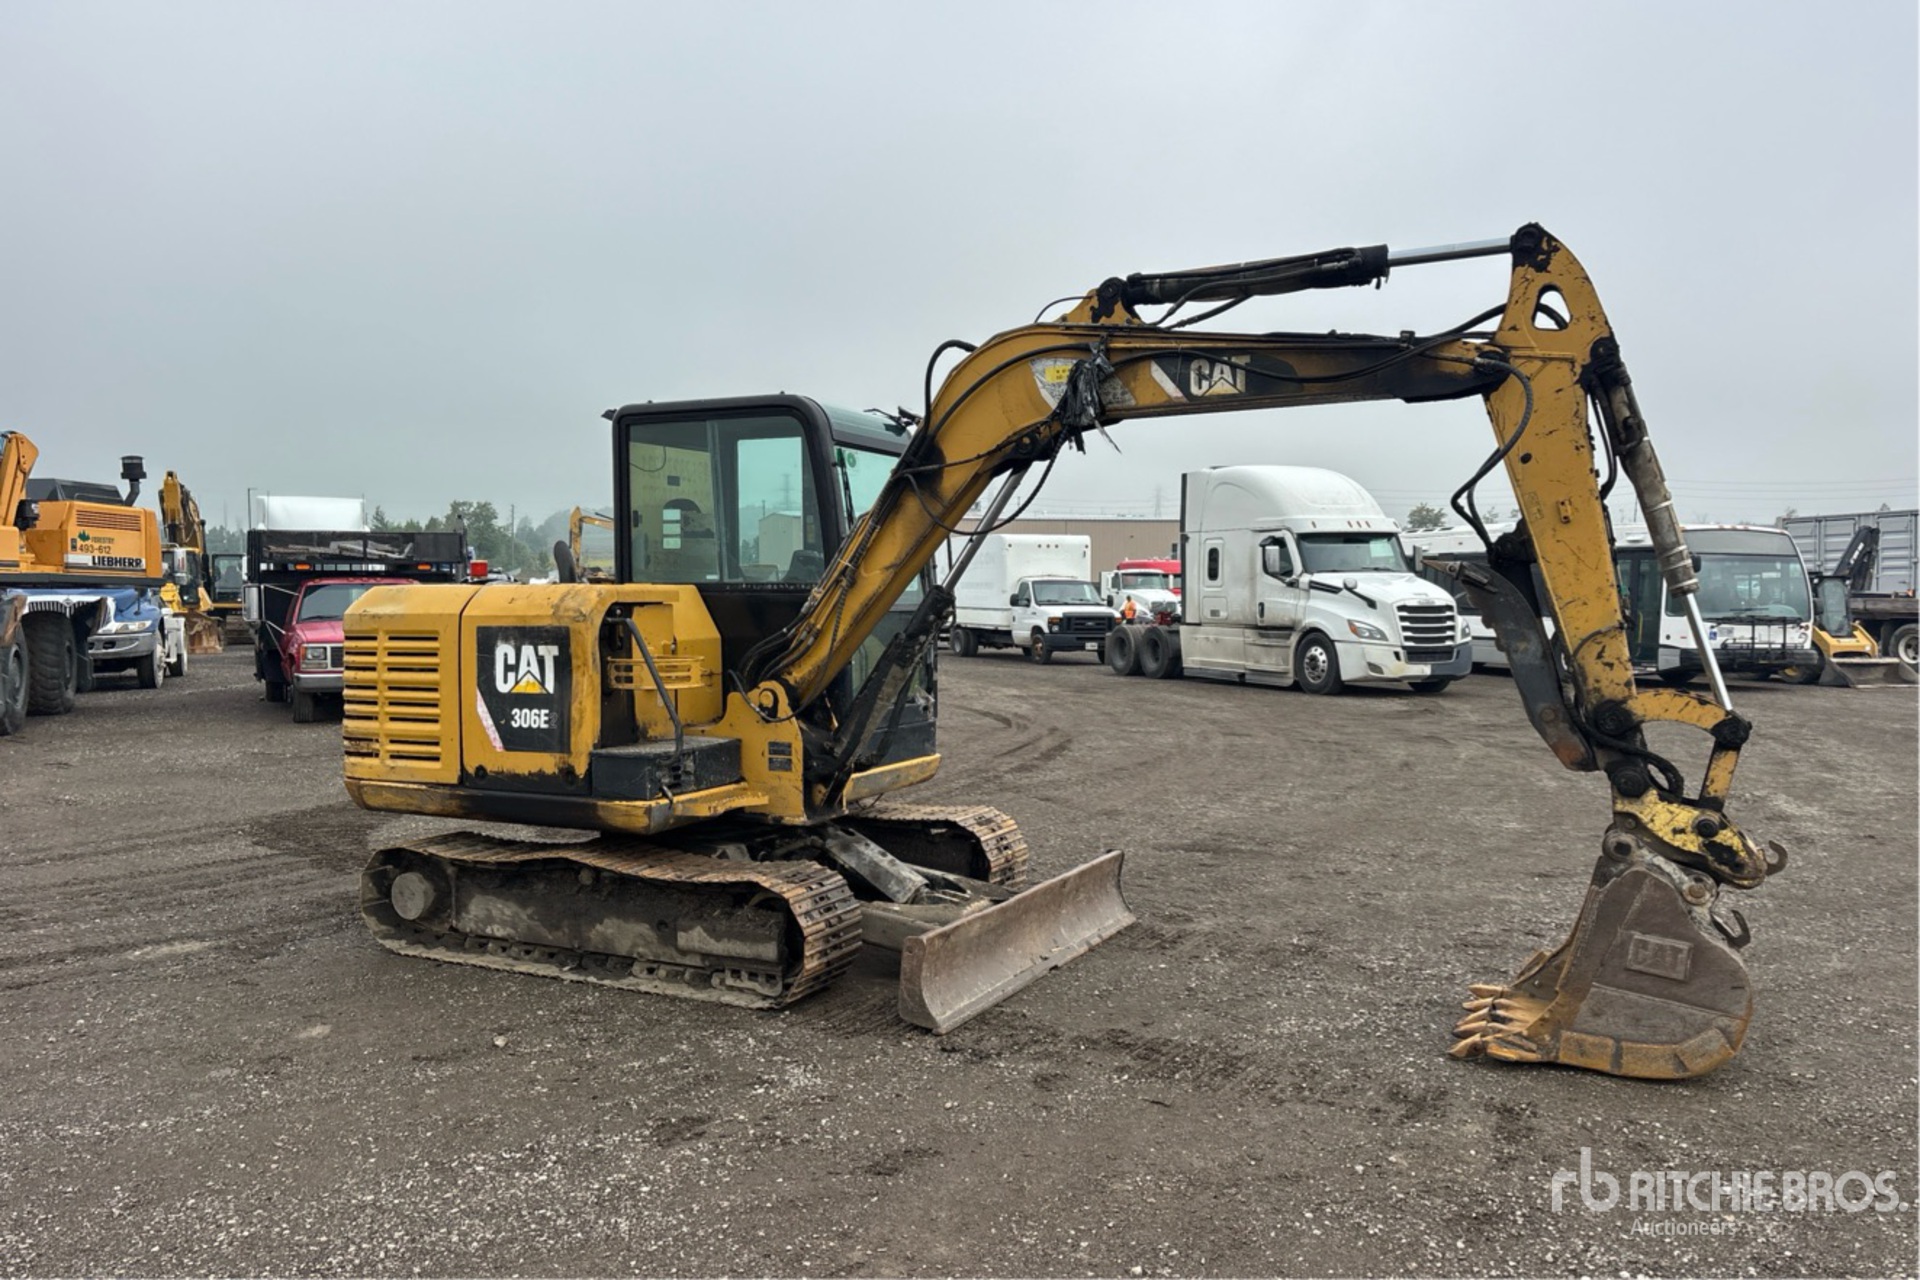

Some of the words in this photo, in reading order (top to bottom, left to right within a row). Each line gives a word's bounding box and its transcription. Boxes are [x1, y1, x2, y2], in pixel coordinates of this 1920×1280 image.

[1190, 354, 1251, 397] CAT
[92, 555, 142, 568] LIEBHERR
[495, 643, 559, 694] CAT
